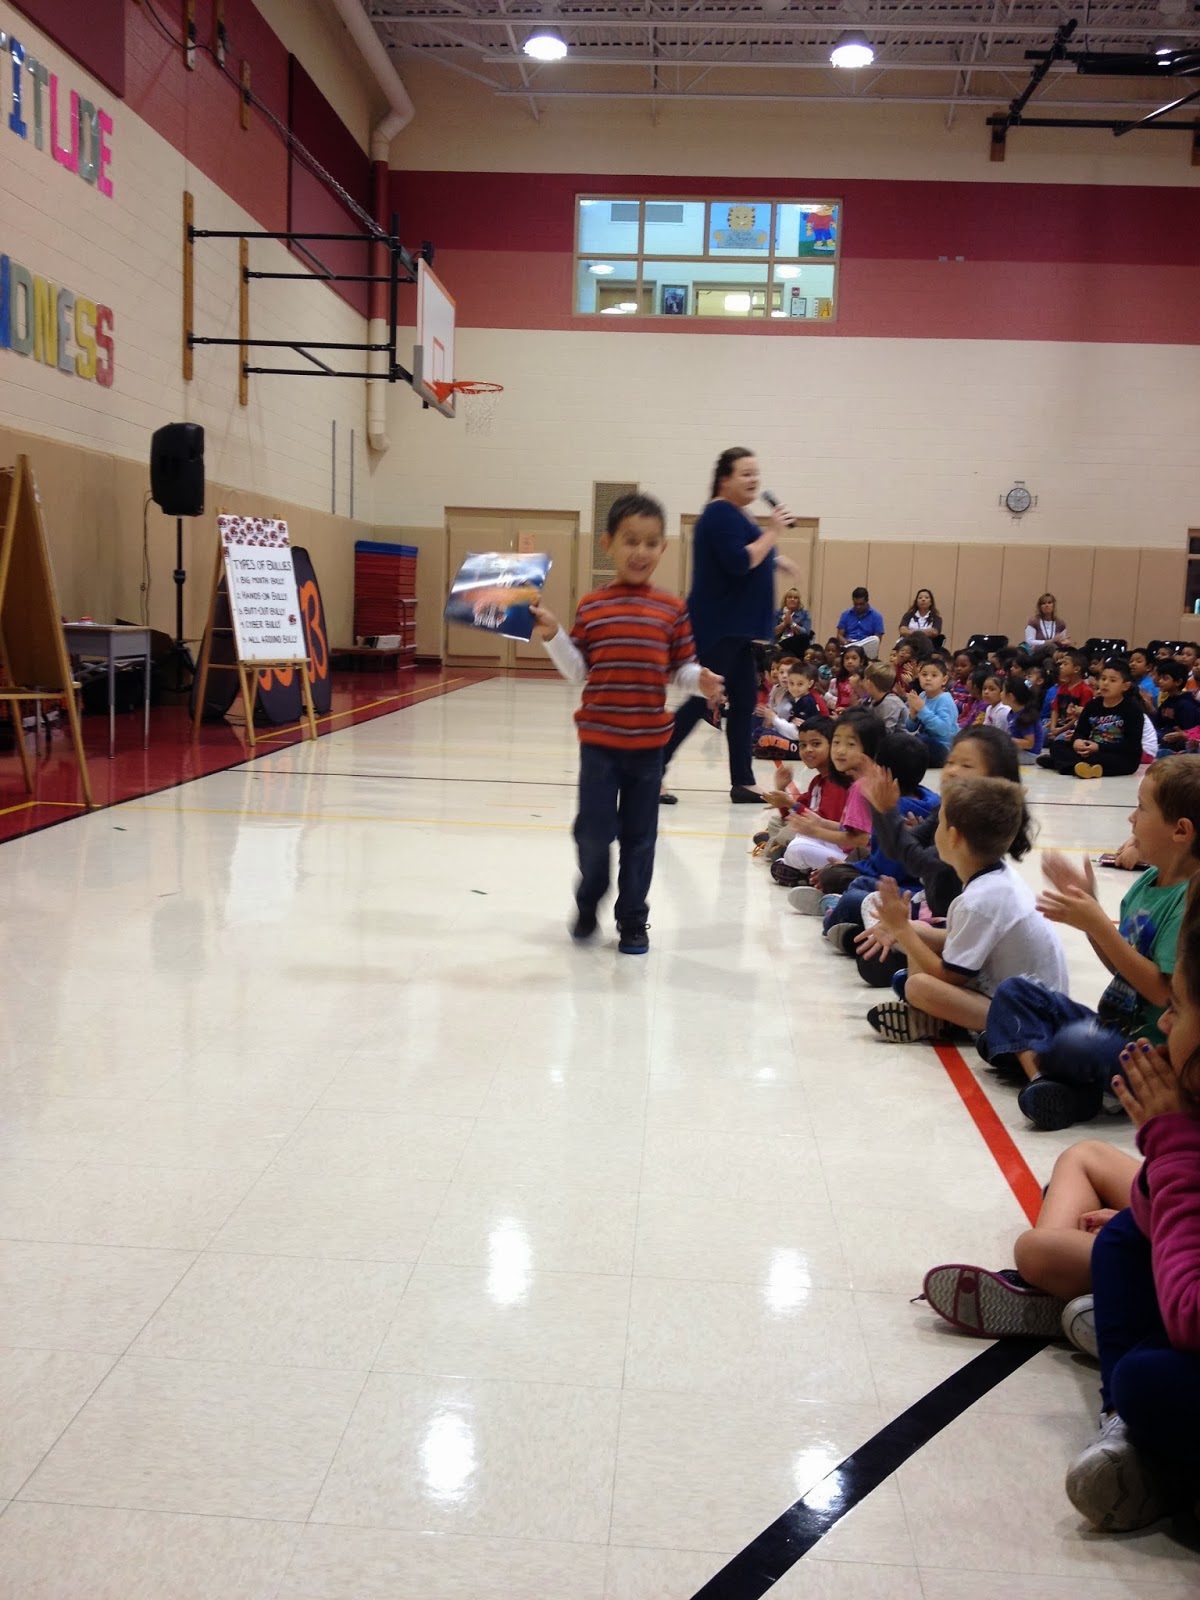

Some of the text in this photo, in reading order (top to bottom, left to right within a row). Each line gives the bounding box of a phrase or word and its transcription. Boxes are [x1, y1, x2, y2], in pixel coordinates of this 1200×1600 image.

[0, 31, 113, 199] ITUDE
[233, 559, 291, 571] TYPES OF BULLIES
